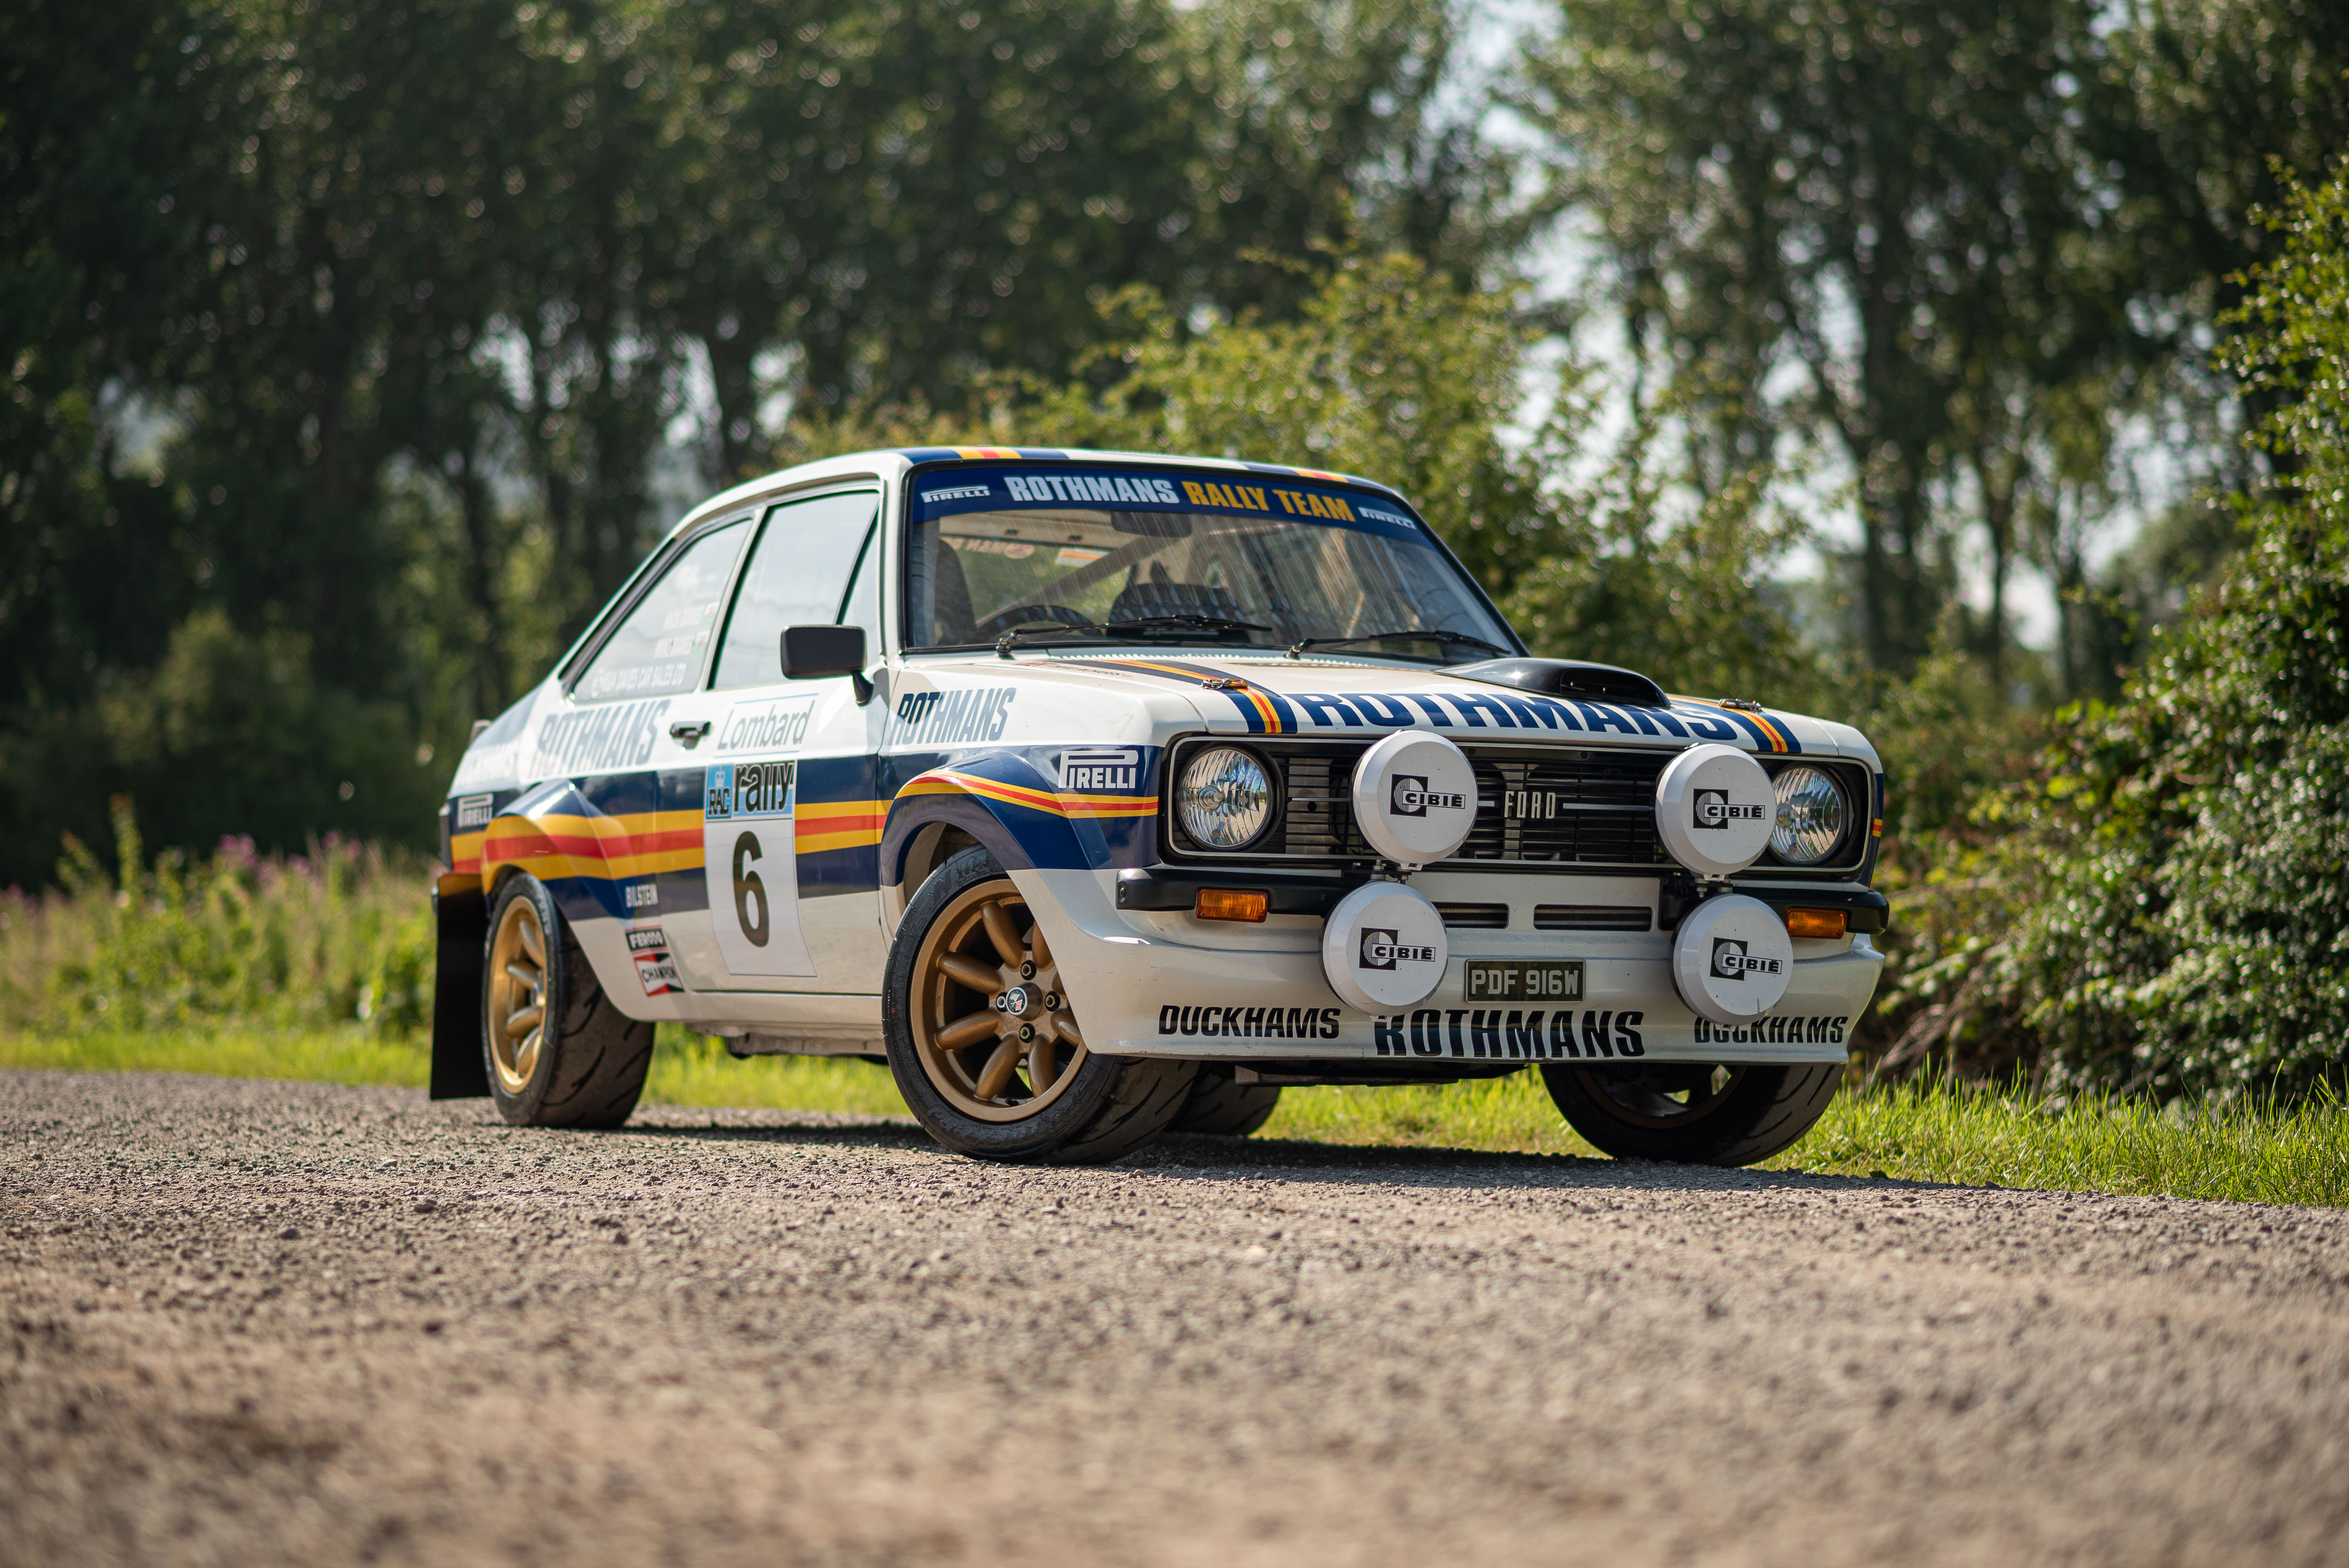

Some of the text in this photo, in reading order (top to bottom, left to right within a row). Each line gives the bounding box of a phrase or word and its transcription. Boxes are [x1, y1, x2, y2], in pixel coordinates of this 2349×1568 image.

[921, 486, 991, 503] PIRELLI
[1004, 476, 1356, 522] ROTHMANS RALLY TEAM
[1358, 507, 1416, 529] PIRELLI
[716, 700, 815, 750] Lombard
[888, 688, 1017, 745] ROTHMANS
[1281, 693, 1738, 741] ROTHMANS
[530, 699, 671, 780] ROTHMANS
[708, 763, 795, 816] RAC rally
[1058, 750, 1139, 788] PIRELLI
[1504, 791, 1556, 819] FORD
[626, 884, 658, 908] BILSTEIN
[732, 831, 769, 948] 6
[1471, 970, 1579, 995] PDF 916W
[1158, 1005, 1341, 1039] DUCKHAMS
[1374, 1009, 1645, 1058] ROTHMANS
[1694, 1015, 1849, 1044] DUCKHAMS
